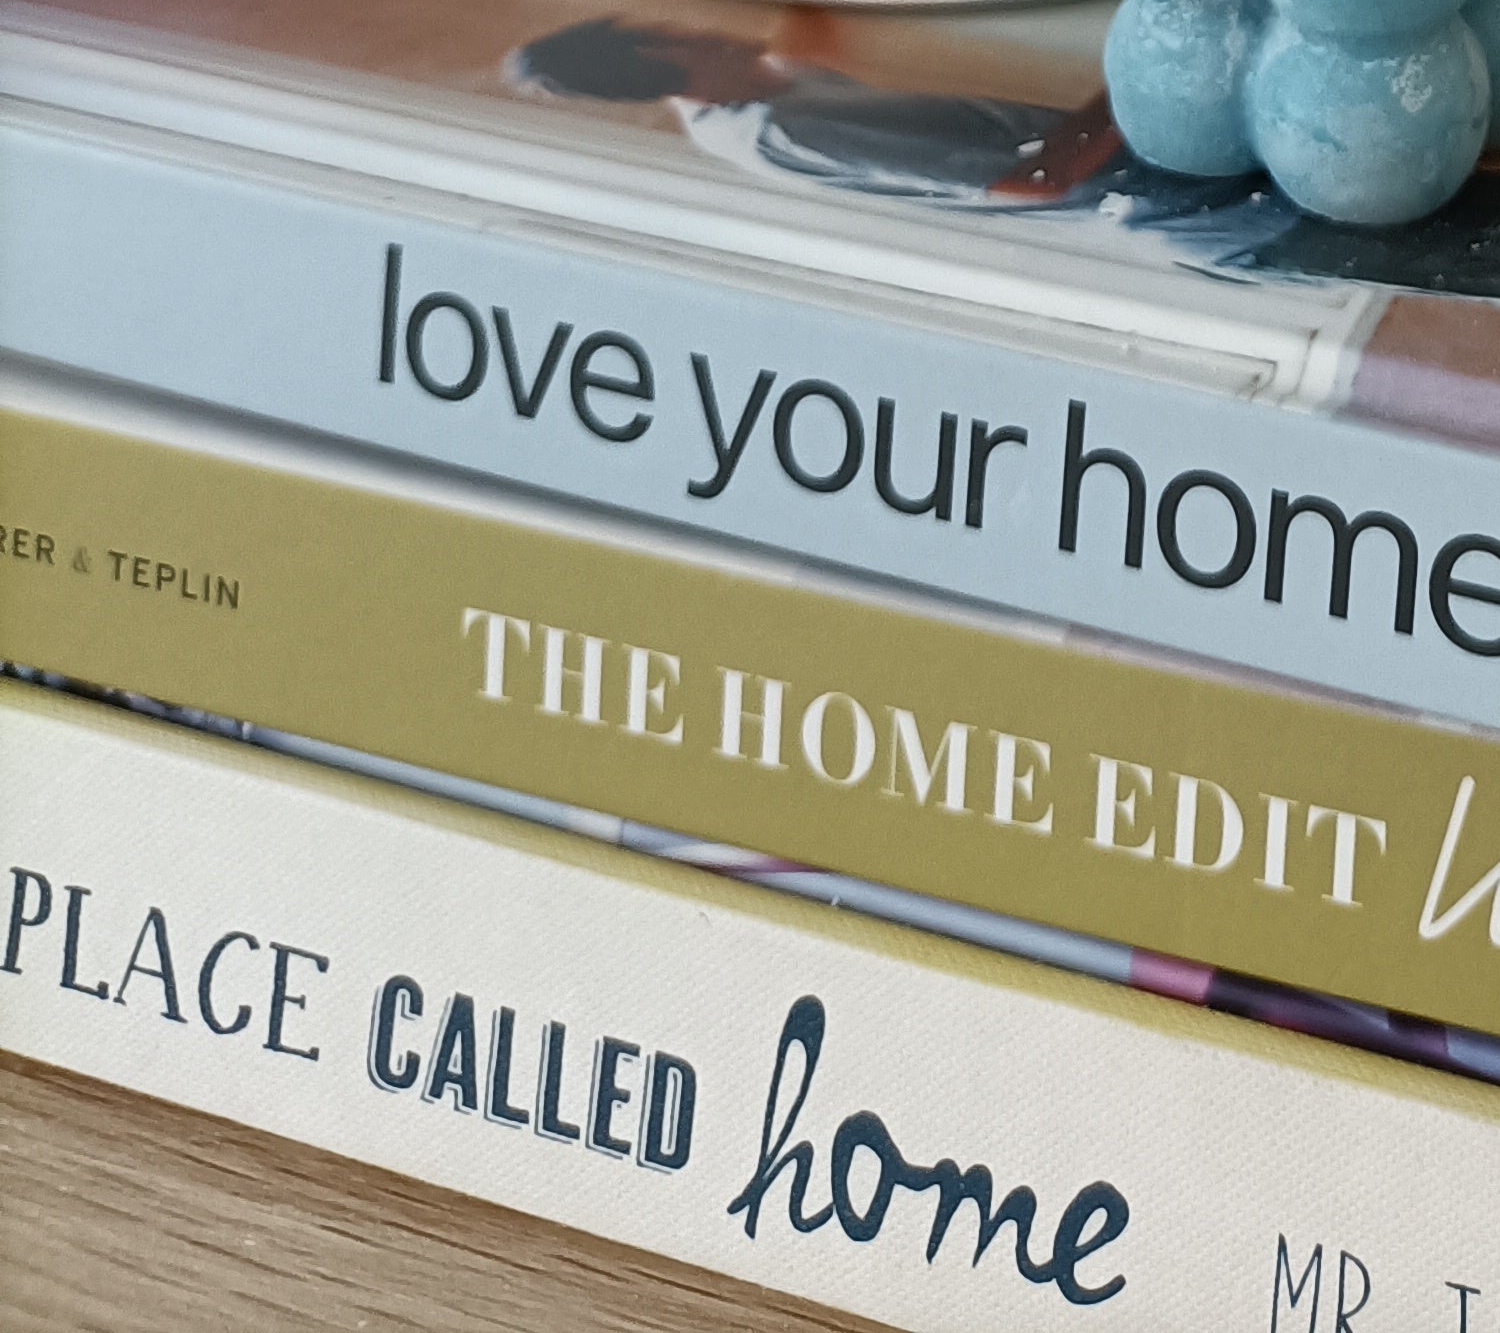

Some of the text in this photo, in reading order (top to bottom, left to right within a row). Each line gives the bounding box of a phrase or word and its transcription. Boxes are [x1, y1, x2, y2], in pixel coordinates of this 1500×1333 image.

[377, 242, 656, 444] love
[686, 351, 1029, 531] your
[72, 546, 92, 574] &
[106, 548, 240, 610] TEPLIN
[461, 606, 684, 745] THE
[714, 666, 1054, 835] HOME
[1085, 753, 1388, 909] EDIT
[0, 866, 1131, 1306] PLACE CALLED home
